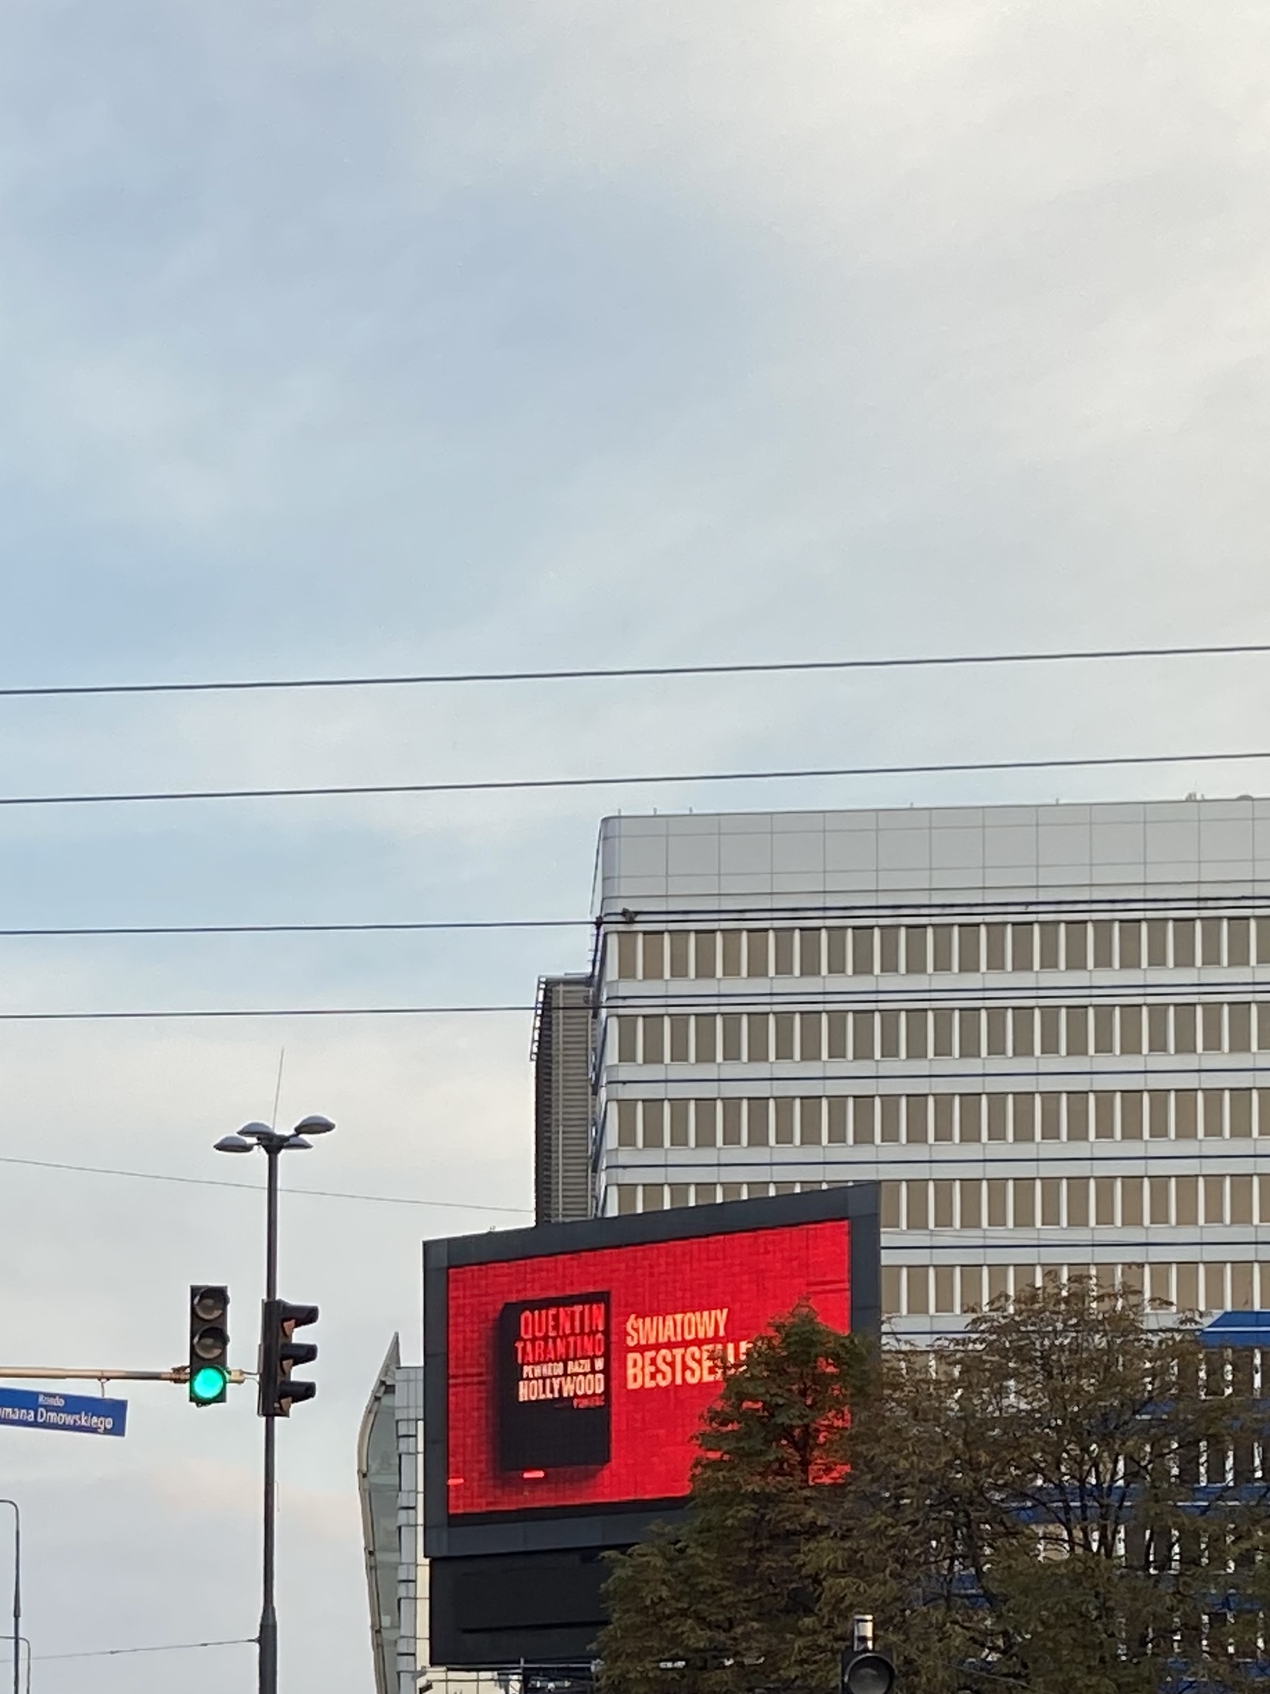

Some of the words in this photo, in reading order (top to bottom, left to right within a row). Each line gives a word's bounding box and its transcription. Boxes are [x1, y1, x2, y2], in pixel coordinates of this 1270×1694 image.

[520, 1302, 605, 1339] QUENTIN
[626, 1308, 728, 1346] ŚWIATOWY
[515, 1332, 605, 1364] TARANTINO
[518, 1373, 605, 1402] HOLLYWOOD
[37, 1407, 113, 1432] Dmowskiego
